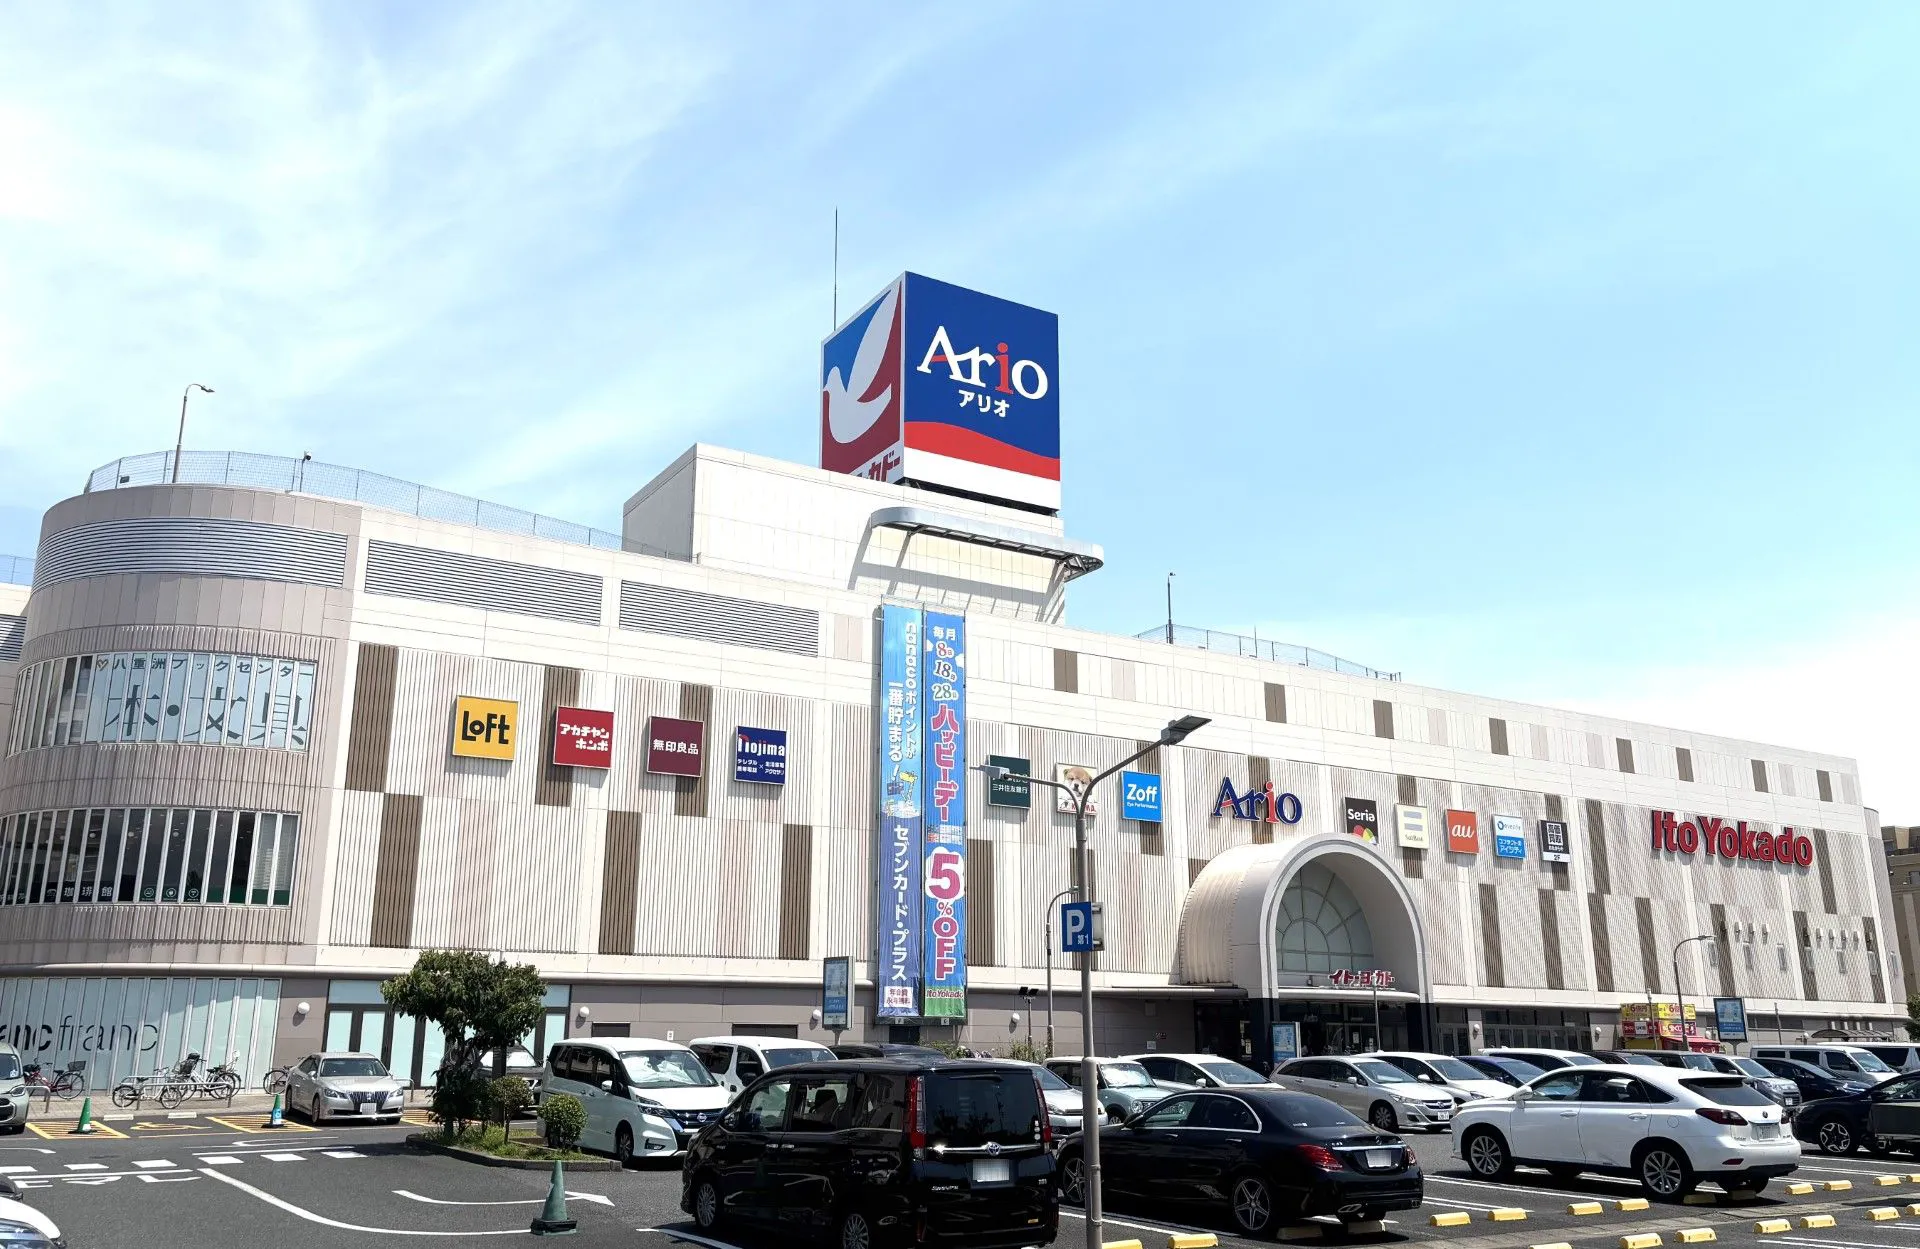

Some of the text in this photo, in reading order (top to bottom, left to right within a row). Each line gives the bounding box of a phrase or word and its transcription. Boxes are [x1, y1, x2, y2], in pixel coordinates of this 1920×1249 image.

[917, 326, 1048, 400] Ario
[958, 390, 1010, 418] アリオ
[857, 450, 900, 482] カドー
[932, 626, 955, 640] 毎月
[653, 739, 699, 755] 無印良品
[932, 704, 960, 821] ハッピーデー
[1127, 783, 1158, 802] Zoff
[1212, 776, 1303, 825] Ario
[1347, 808, 1376, 822] Seria
[1452, 824, 1475, 839] au
[892, 824, 910, 981] セブンカード・プラス
[1066, 909, 1085, 946] P
